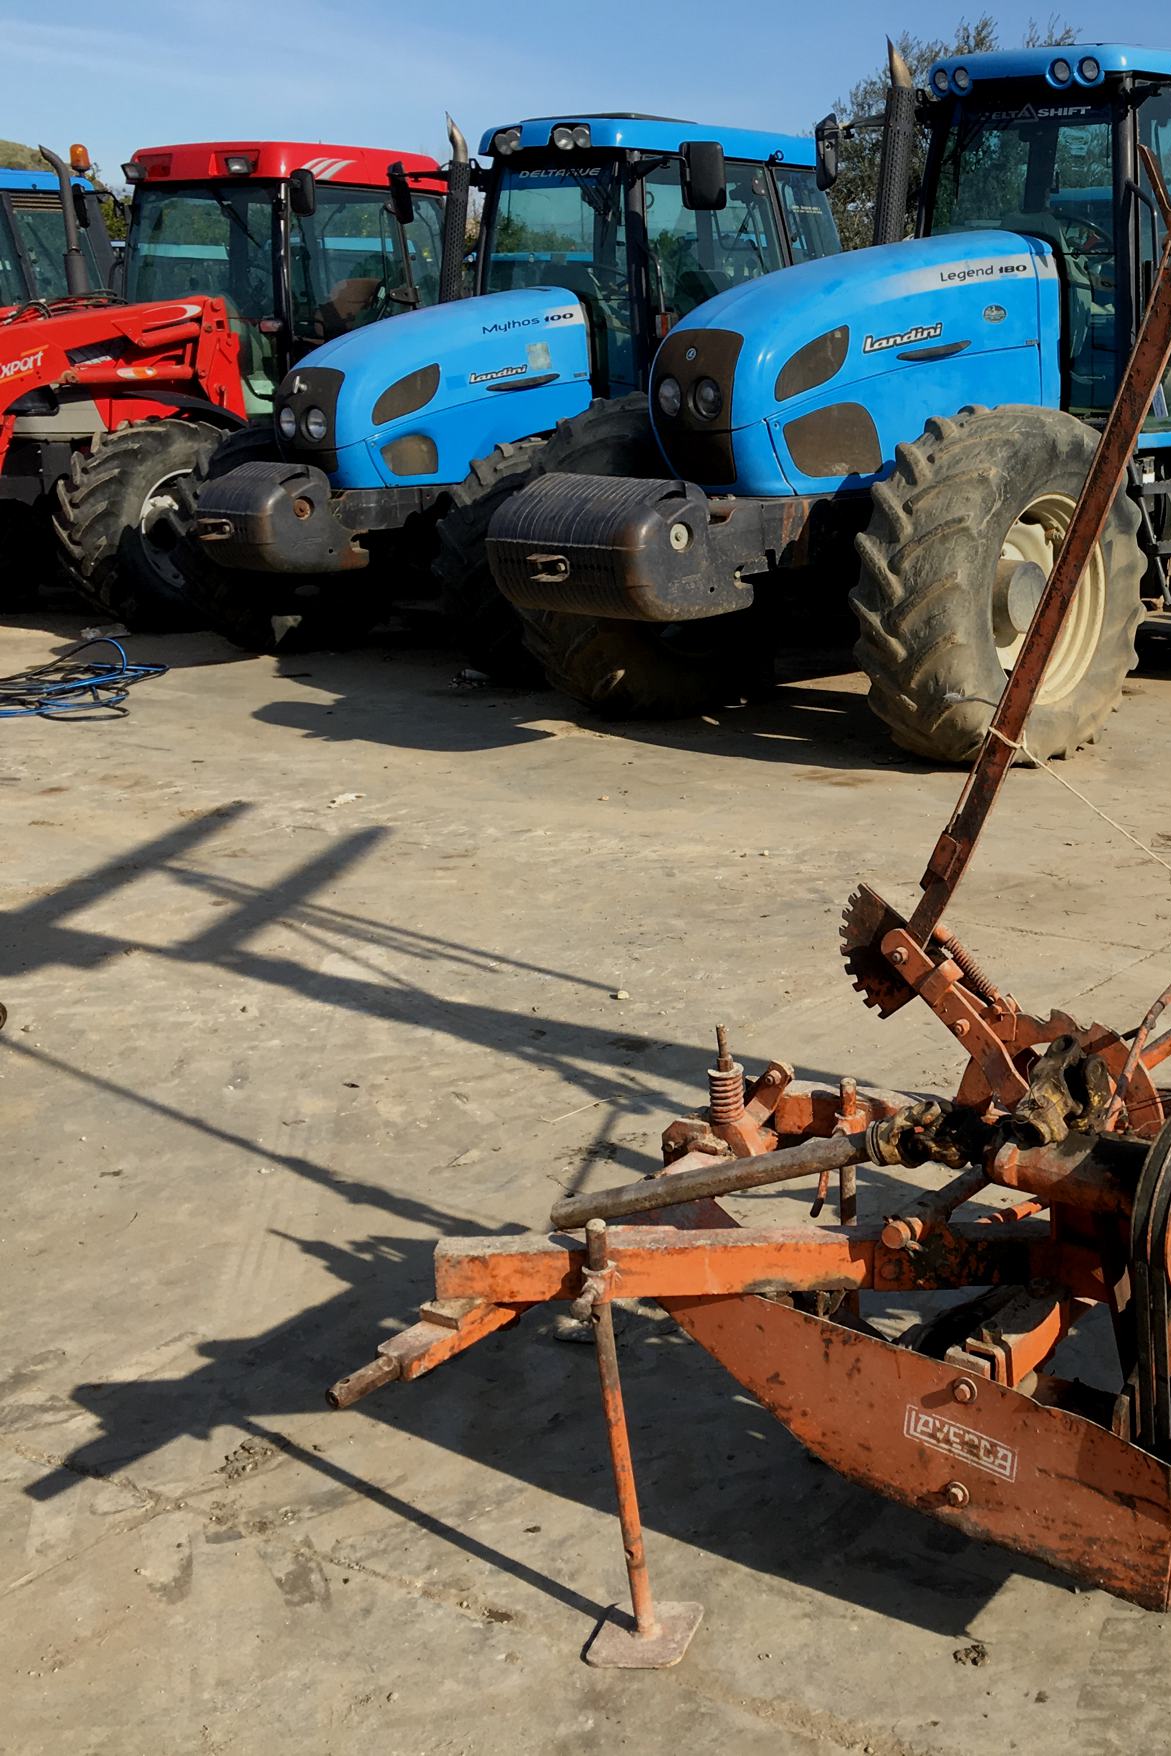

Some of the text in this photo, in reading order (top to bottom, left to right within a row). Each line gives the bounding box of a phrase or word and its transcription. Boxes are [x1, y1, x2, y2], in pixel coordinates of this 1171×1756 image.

[940, 264, 1027, 283] Legend 180
[482, 312, 574, 335] Mythos 100
[863, 322, 943, 354] Landini
[469, 364, 528, 384] Landini
